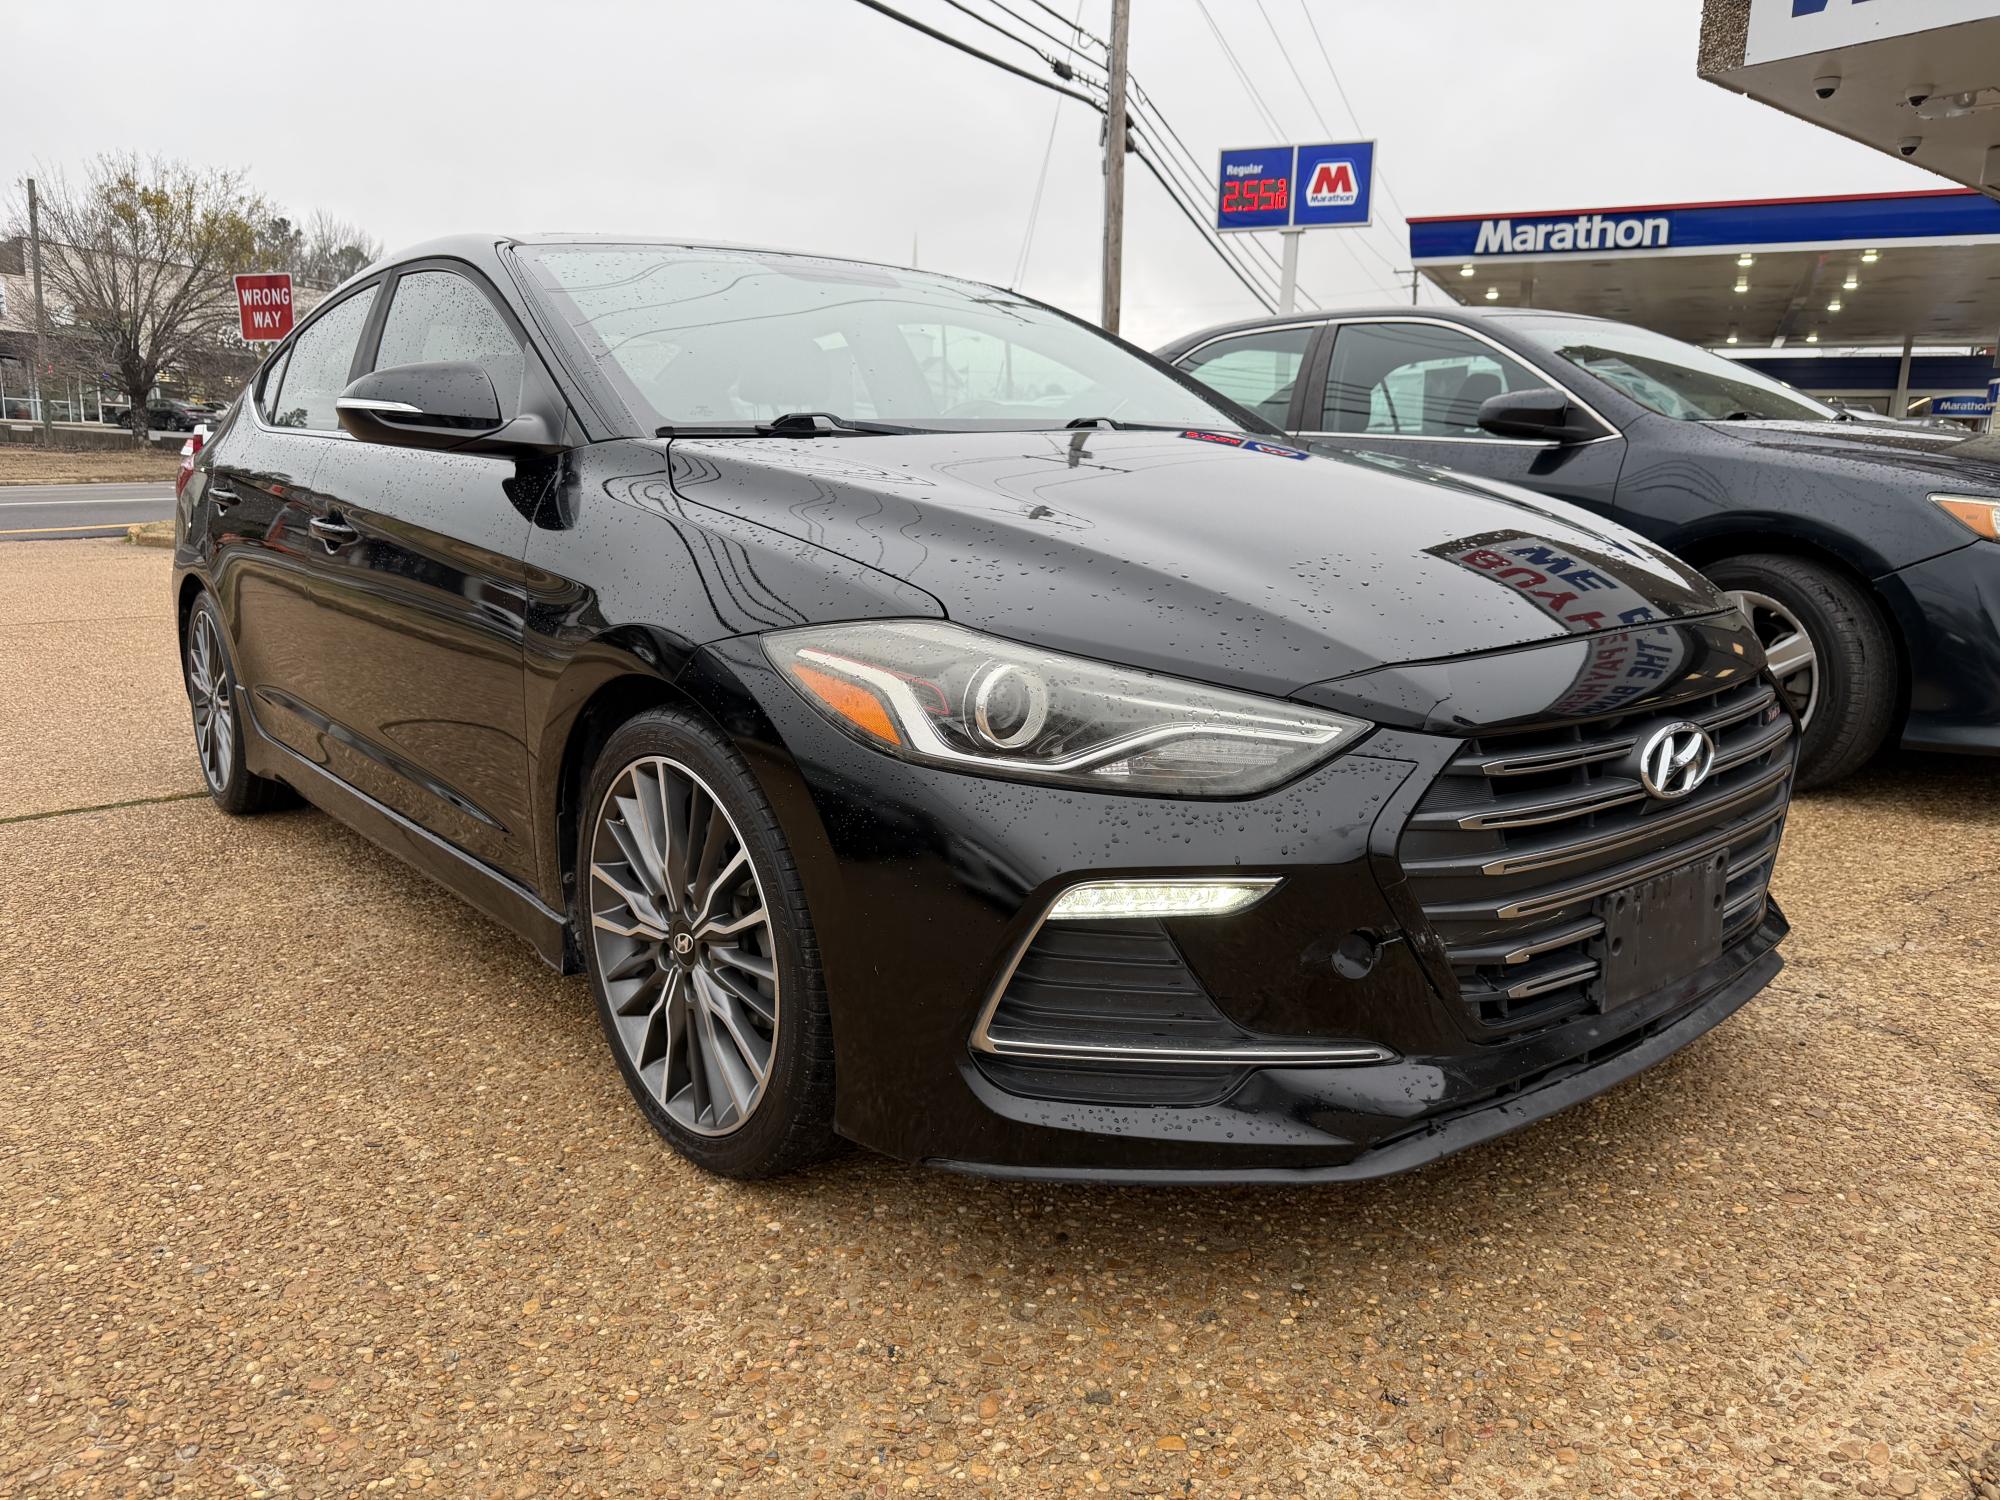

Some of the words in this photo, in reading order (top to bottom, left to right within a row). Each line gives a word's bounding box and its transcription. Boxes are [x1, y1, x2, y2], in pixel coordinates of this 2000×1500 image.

[1227, 163, 1262, 177] Regular
[1311, 194, 1354, 203] Marathon
[1474, 215, 1669, 254] Marathon
[241, 287, 290, 306] WRONG
[253, 310, 281, 328] WAY
